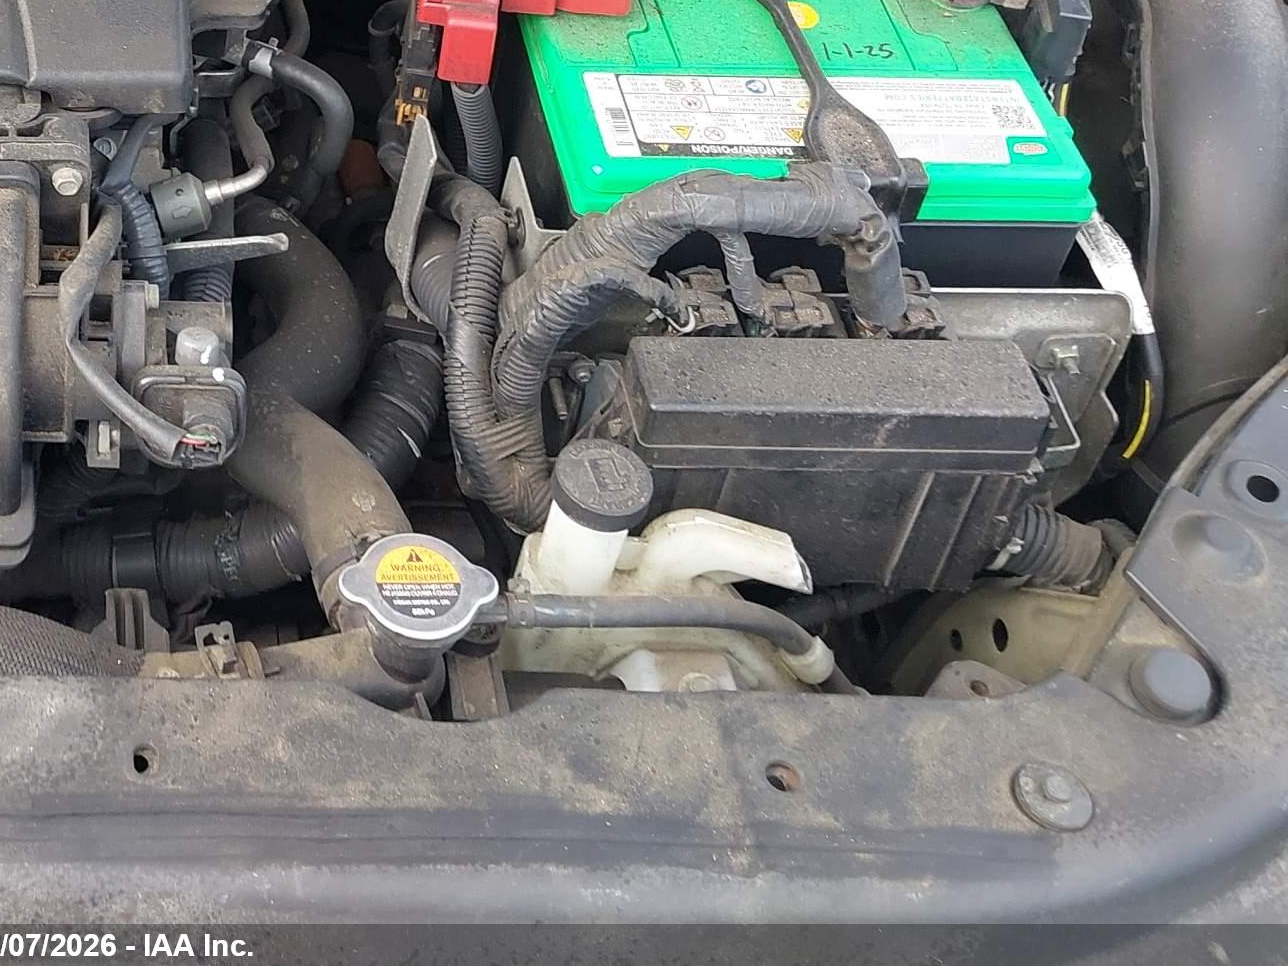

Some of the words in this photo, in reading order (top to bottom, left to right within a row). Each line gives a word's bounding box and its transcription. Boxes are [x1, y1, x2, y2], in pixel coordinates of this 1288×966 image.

[822, 41, 895, 61] 1-1-25
[691, 144, 794, 156] DANGER/POISON
[390, 564, 441, 572] WARNING
[380, 573, 455, 582] AVERTISSEMENT
